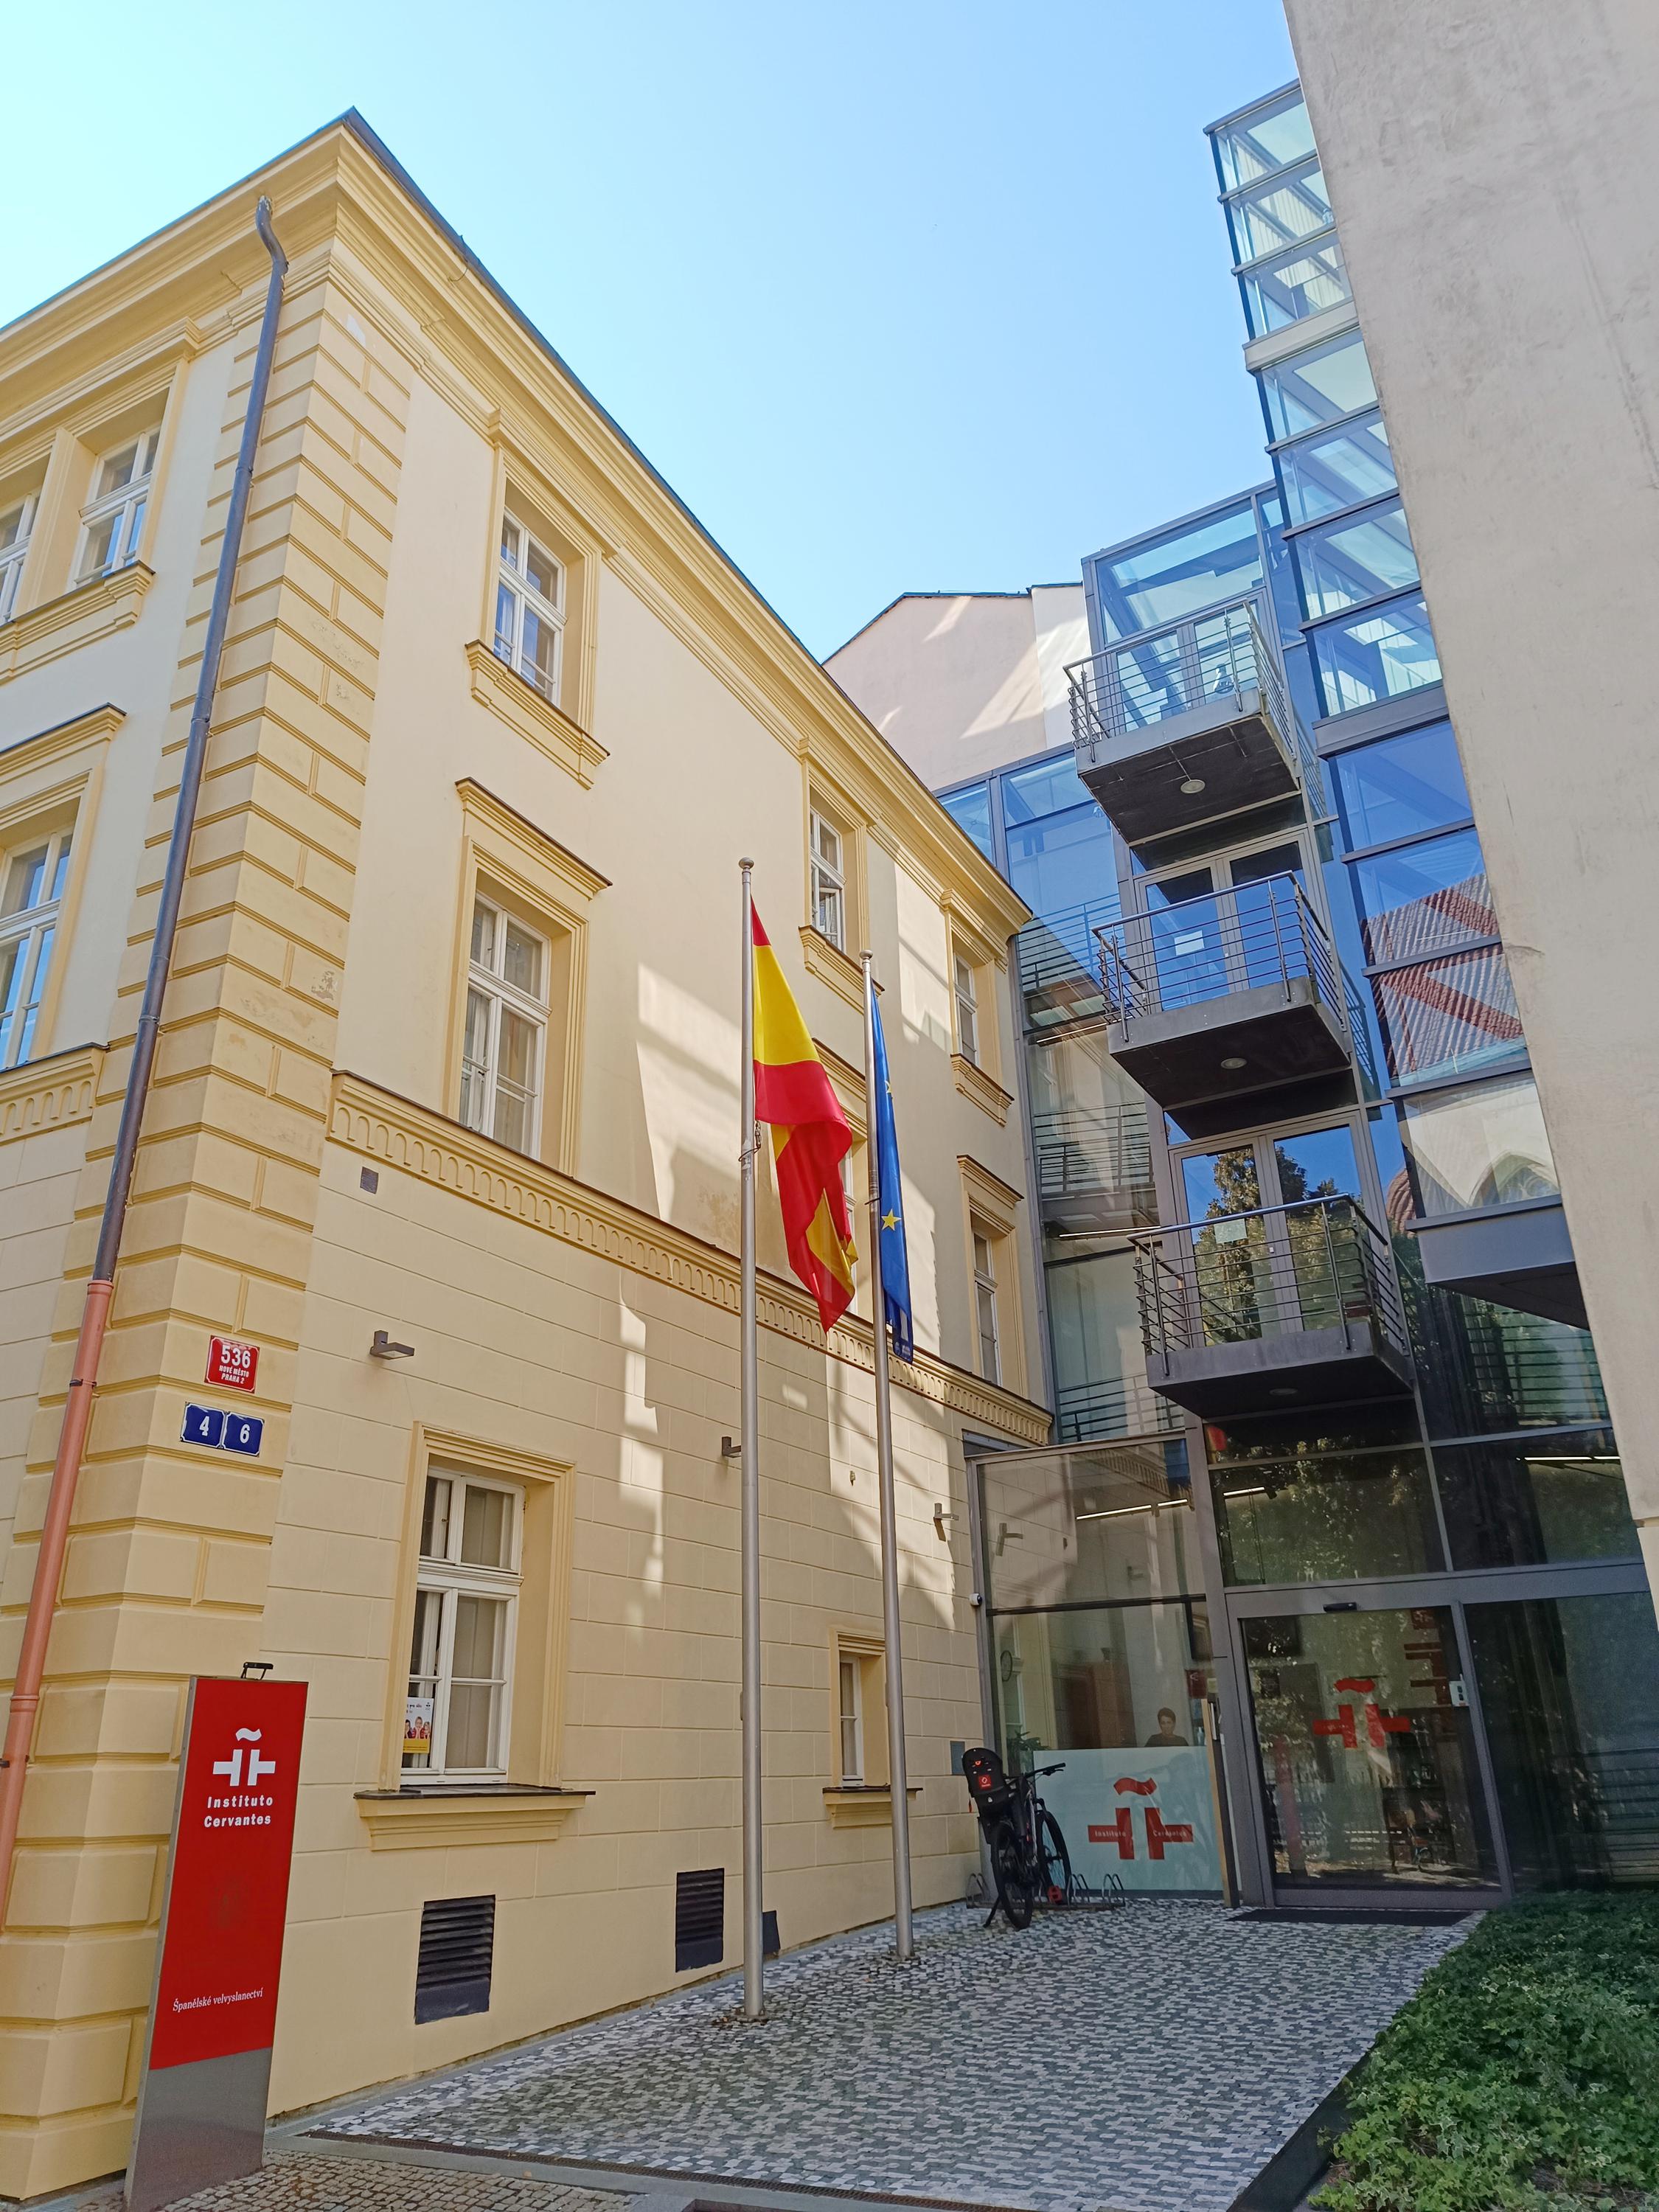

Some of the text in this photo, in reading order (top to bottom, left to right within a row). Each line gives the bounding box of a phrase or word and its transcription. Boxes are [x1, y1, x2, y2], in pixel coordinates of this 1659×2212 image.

[221, 1344, 251, 1368] 536
[219, 1365, 249, 1377] NOVÉ MĚSTO
[221, 1373, 240, 1383] PRAHA
[199, 1416, 250, 1444] 4 6
[207, 1795, 273, 1809] Instituto
[204, 1813, 271, 1828] Cervantes
[1094, 1829, 1127, 1837] Instituto
[173, 1987, 264, 2013] Španělské velvyslanectví
